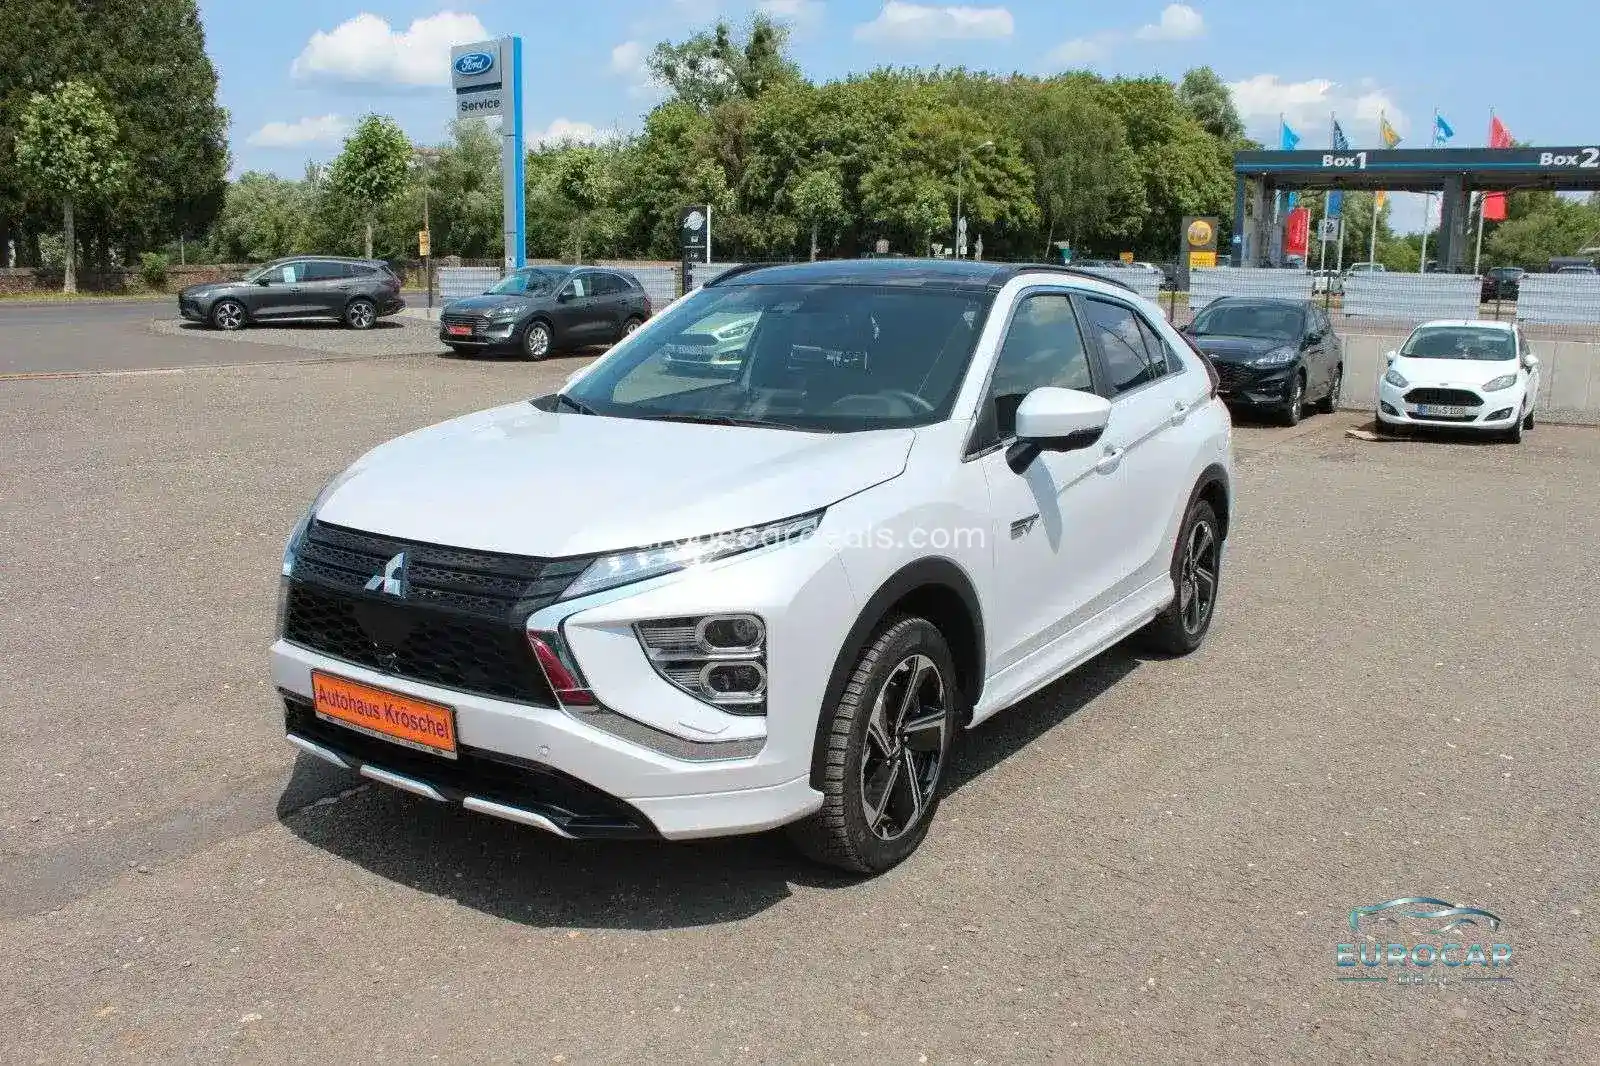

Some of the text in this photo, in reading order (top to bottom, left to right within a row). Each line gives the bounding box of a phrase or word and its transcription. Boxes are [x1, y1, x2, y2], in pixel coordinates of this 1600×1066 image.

[462, 55, 485, 71] Ford
[461, 99, 501, 112] Service
[318, 683, 381, 720] Autohaus
[384, 702, 449, 739] Kröschel
